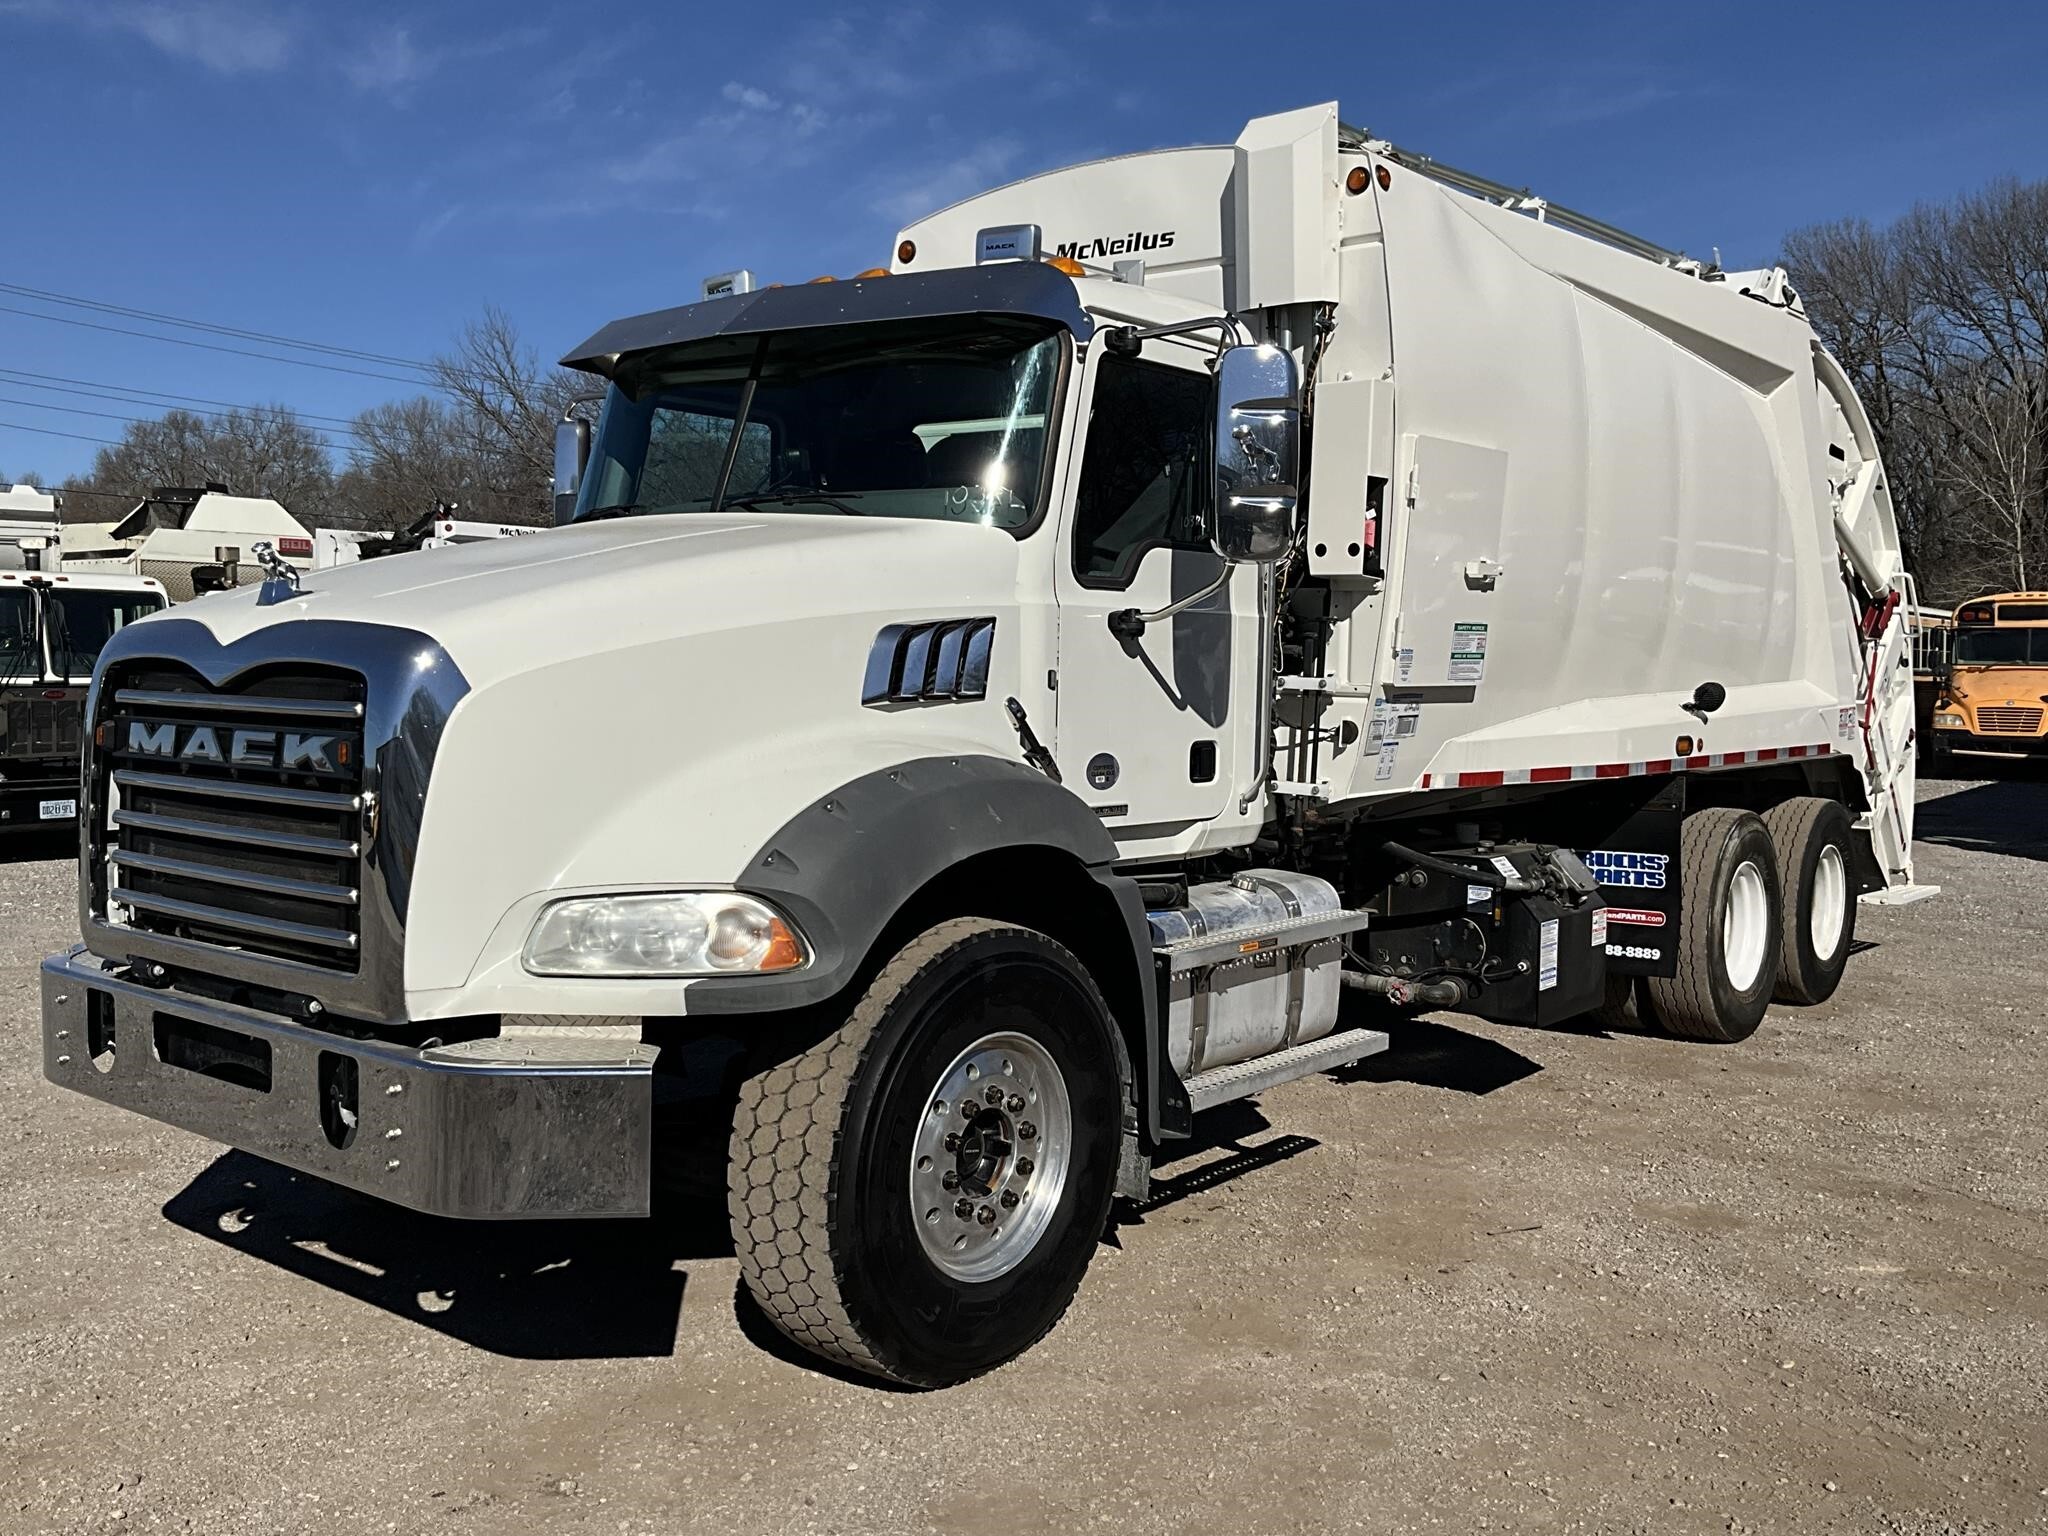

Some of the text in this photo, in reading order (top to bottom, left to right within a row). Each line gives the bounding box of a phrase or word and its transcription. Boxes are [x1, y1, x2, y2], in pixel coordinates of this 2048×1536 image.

[985, 242, 1015, 251] MACK
[1056, 231, 1175, 260] McNeilus
[281, 540, 309, 550] HEIL
[128, 721, 336, 773] MACK
[1585, 851, 1665, 873] RUCKS
[1593, 868, 1666, 889] ARTS
[1606, 911, 1663, 923] andPARTS.com
[1605, 944, 1661, 960] 88-8889
